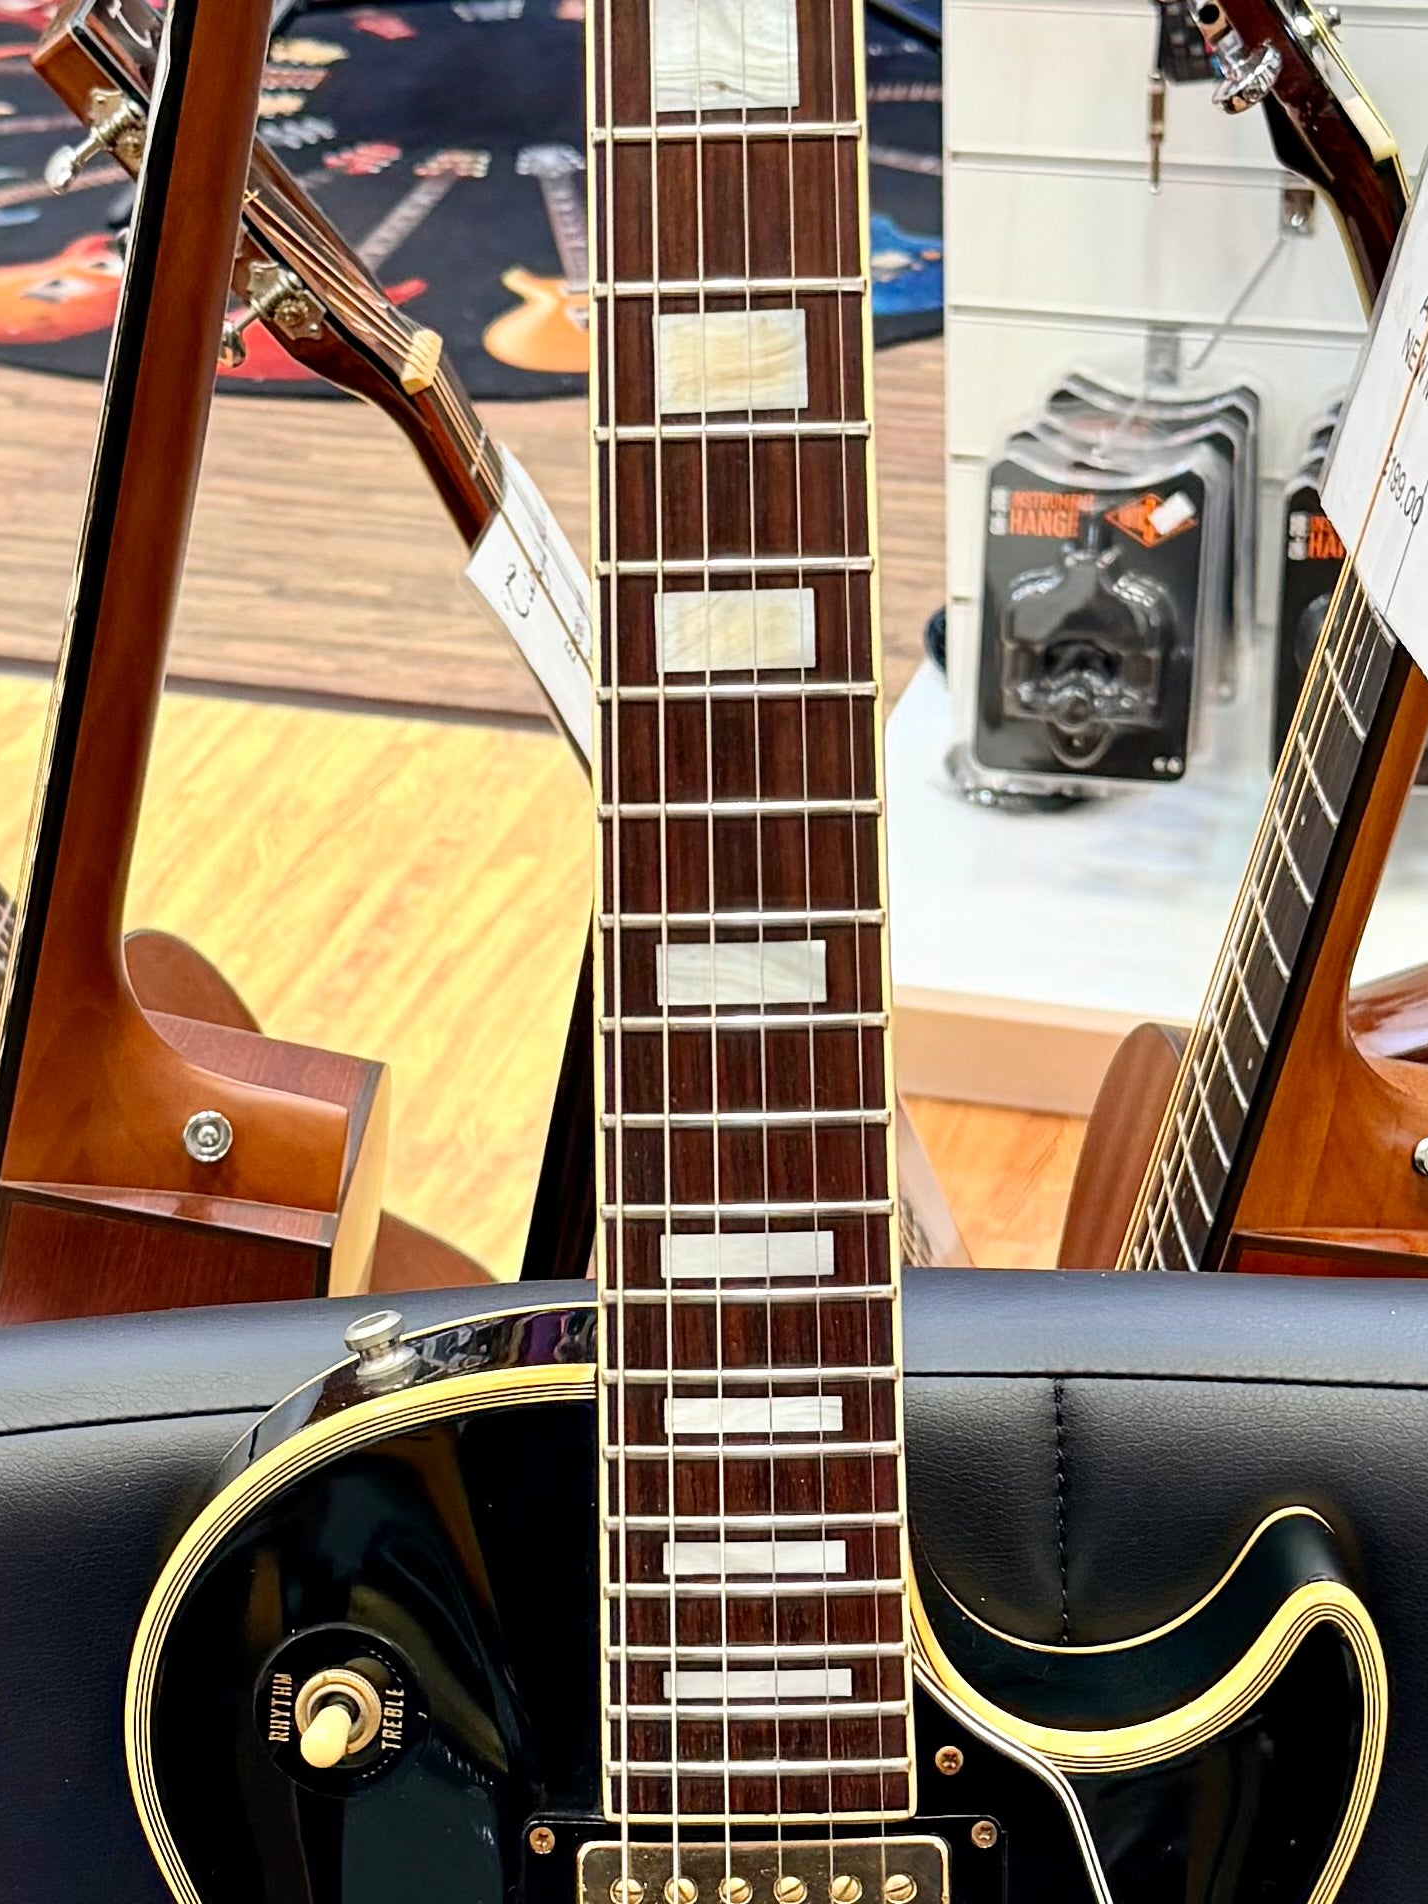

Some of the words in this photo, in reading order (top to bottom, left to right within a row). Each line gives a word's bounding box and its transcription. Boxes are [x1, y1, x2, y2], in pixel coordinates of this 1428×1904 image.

[1009, 508, 1080, 538] HANGE
[268, 1673, 293, 1742] RHYTHM
[381, 1689, 405, 1750] TREBLE
